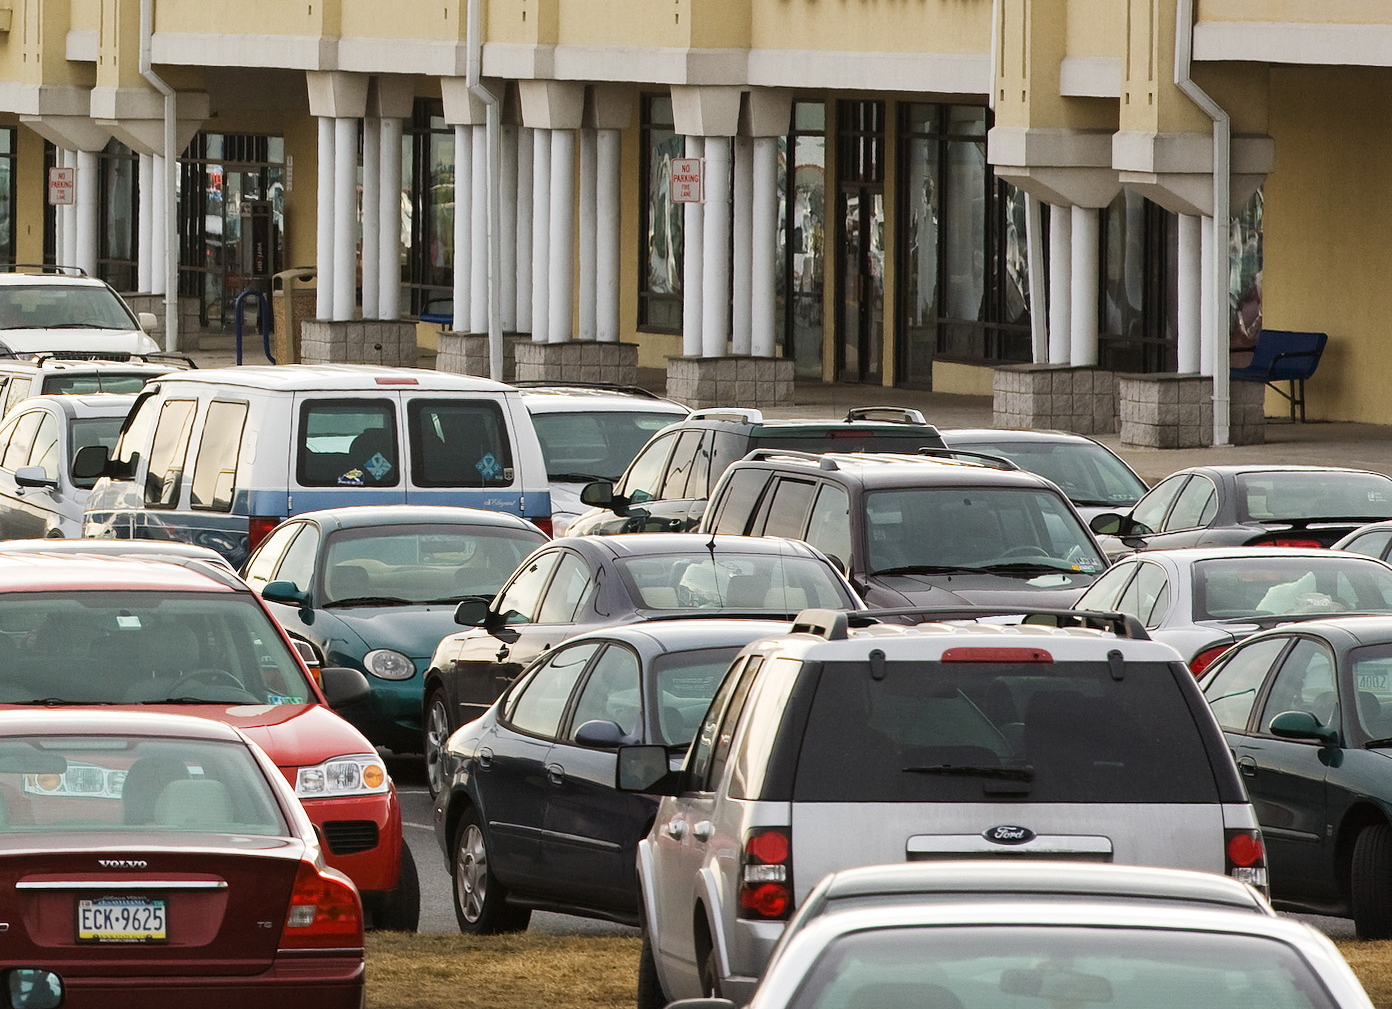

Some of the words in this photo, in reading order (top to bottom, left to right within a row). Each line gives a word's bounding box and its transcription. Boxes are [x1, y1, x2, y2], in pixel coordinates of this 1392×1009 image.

[681, 164, 690, 173] NO
[58, 172, 66, 180] NO
[673, 174, 699, 183] PARKING
[994, 826, 1025, 839] Ford
[98, 859, 148, 868] VOLVO
